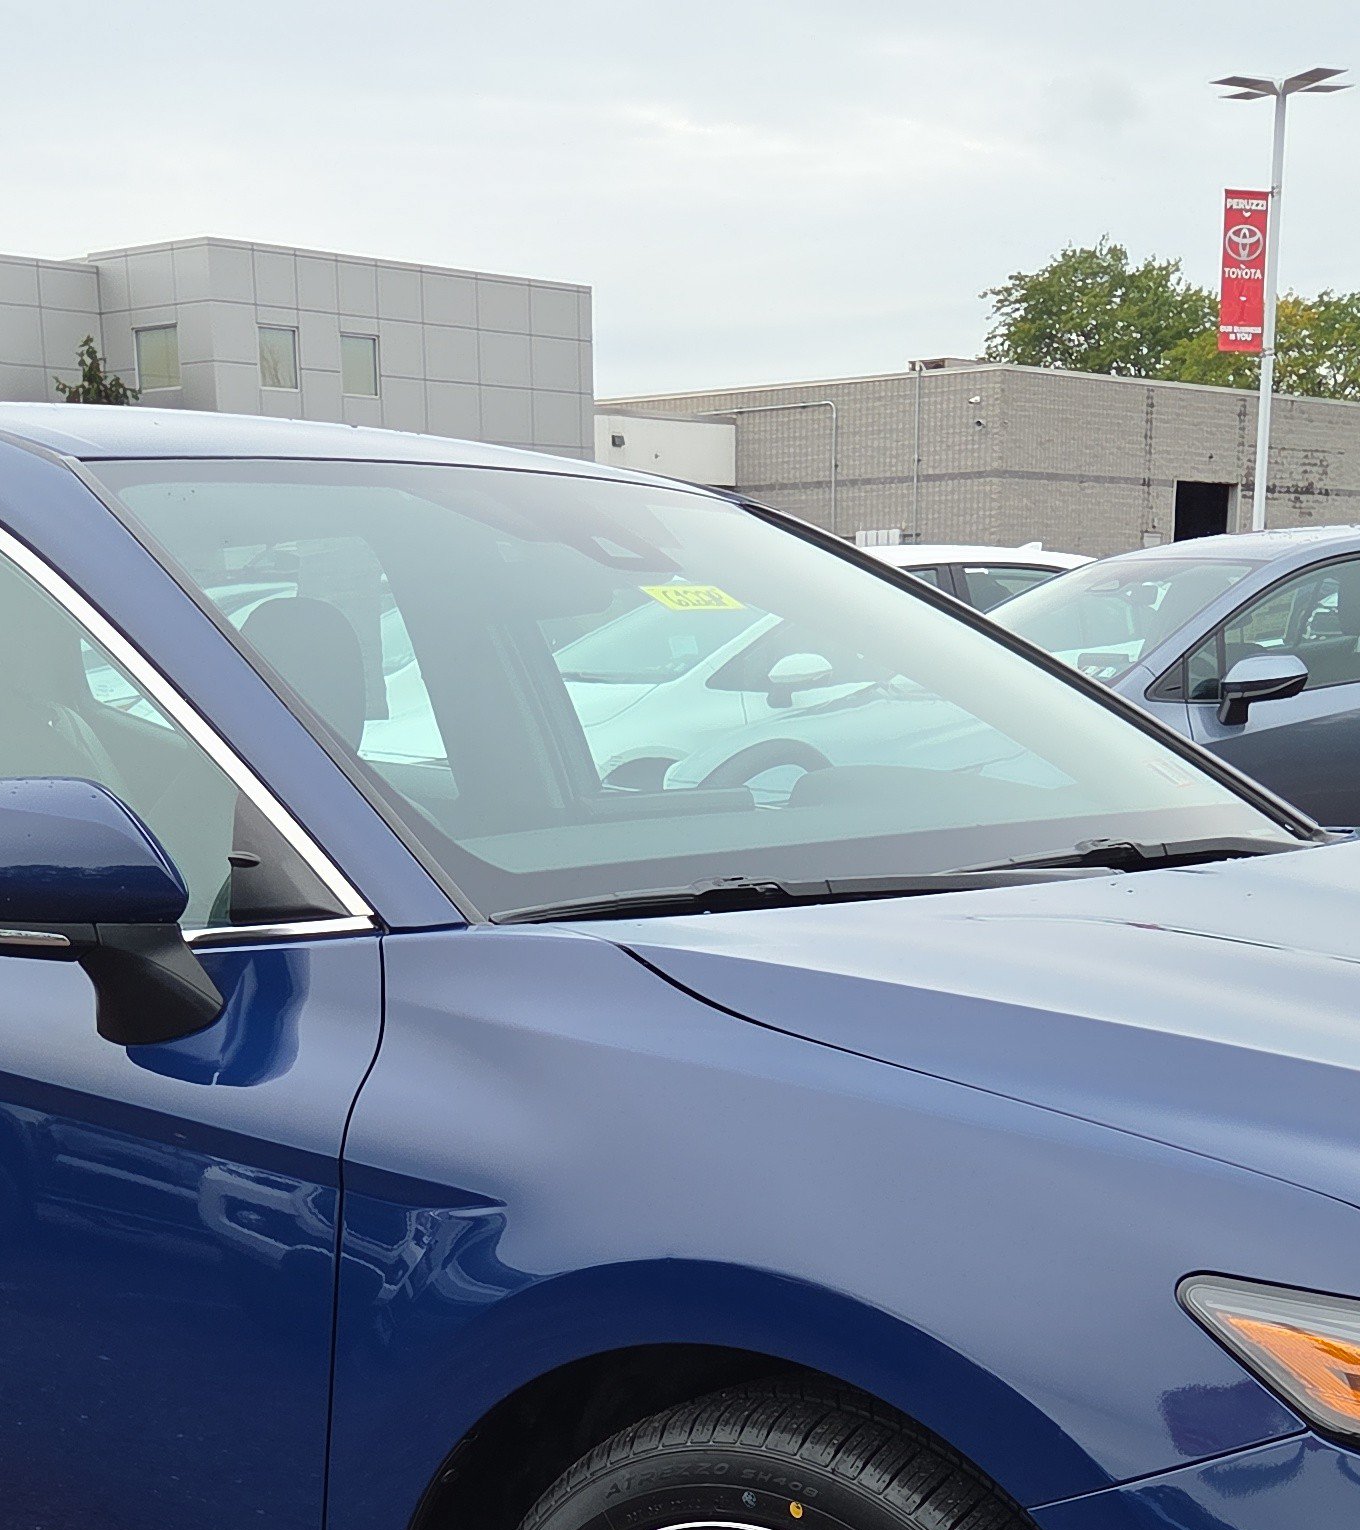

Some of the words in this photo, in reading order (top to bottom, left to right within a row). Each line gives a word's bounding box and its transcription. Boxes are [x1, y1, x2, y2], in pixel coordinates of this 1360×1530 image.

[1227, 198, 1267, 211] PERUZZI
[1223, 267, 1263, 280] TOYOTA
[605, 1462, 730, 1500] ATREZZO
